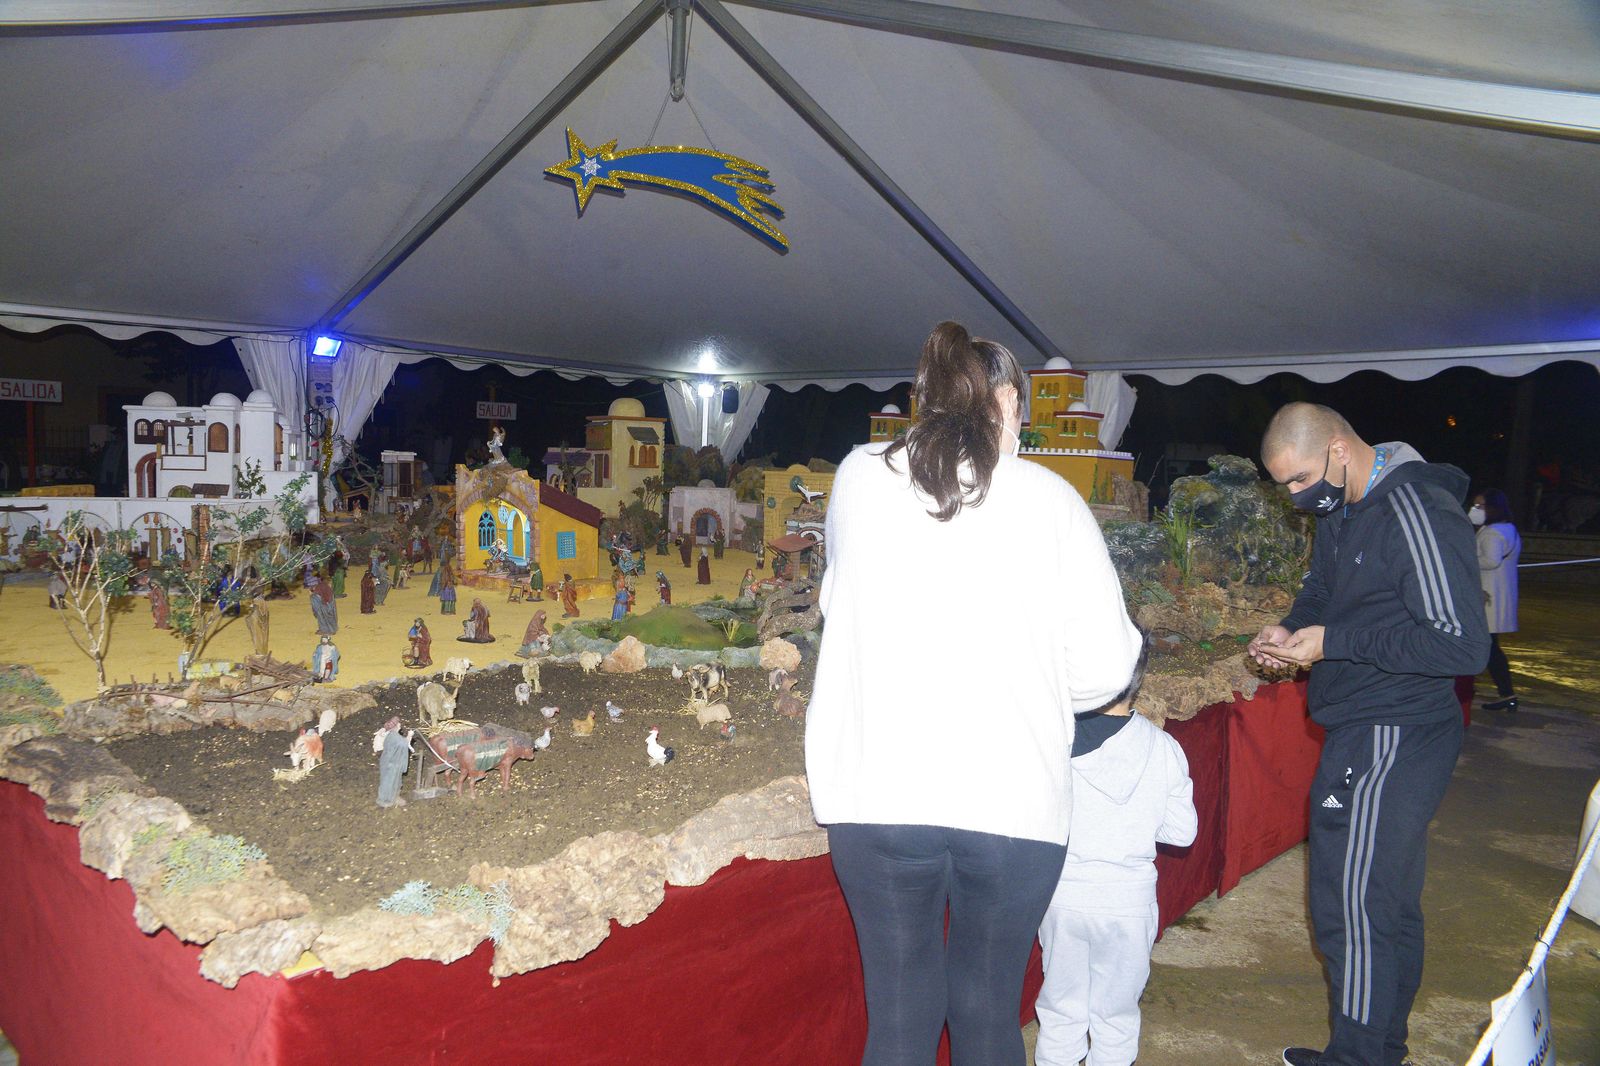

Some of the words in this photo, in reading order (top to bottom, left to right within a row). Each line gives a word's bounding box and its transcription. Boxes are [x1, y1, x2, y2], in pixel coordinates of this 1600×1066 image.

[0, 381, 57, 399] SALIDA
[478, 403, 513, 418] SALIDA
[1532, 1007, 1542, 1037] NO
